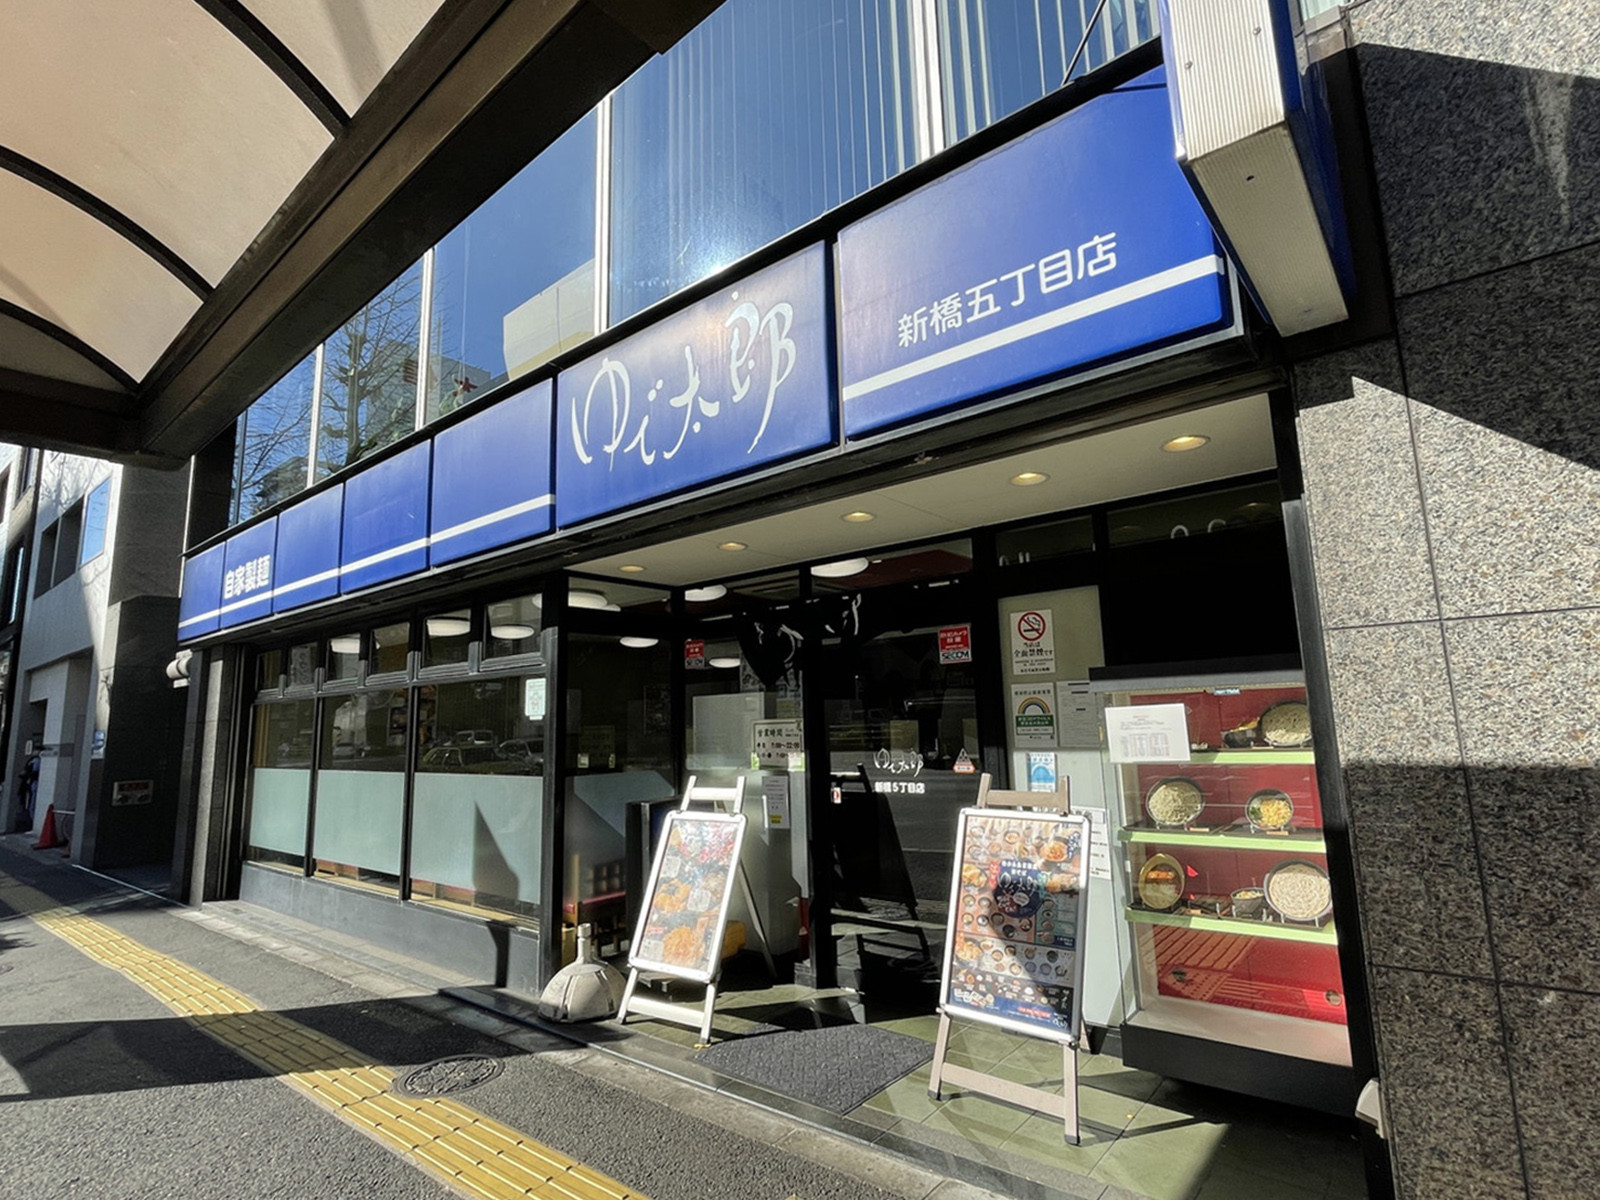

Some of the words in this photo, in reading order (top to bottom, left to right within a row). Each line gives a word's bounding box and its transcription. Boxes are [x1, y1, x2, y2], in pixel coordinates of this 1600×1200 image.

[897, 232, 1119, 349] 新橋五丁目店
[570, 291, 797, 471] ゆで太郎
